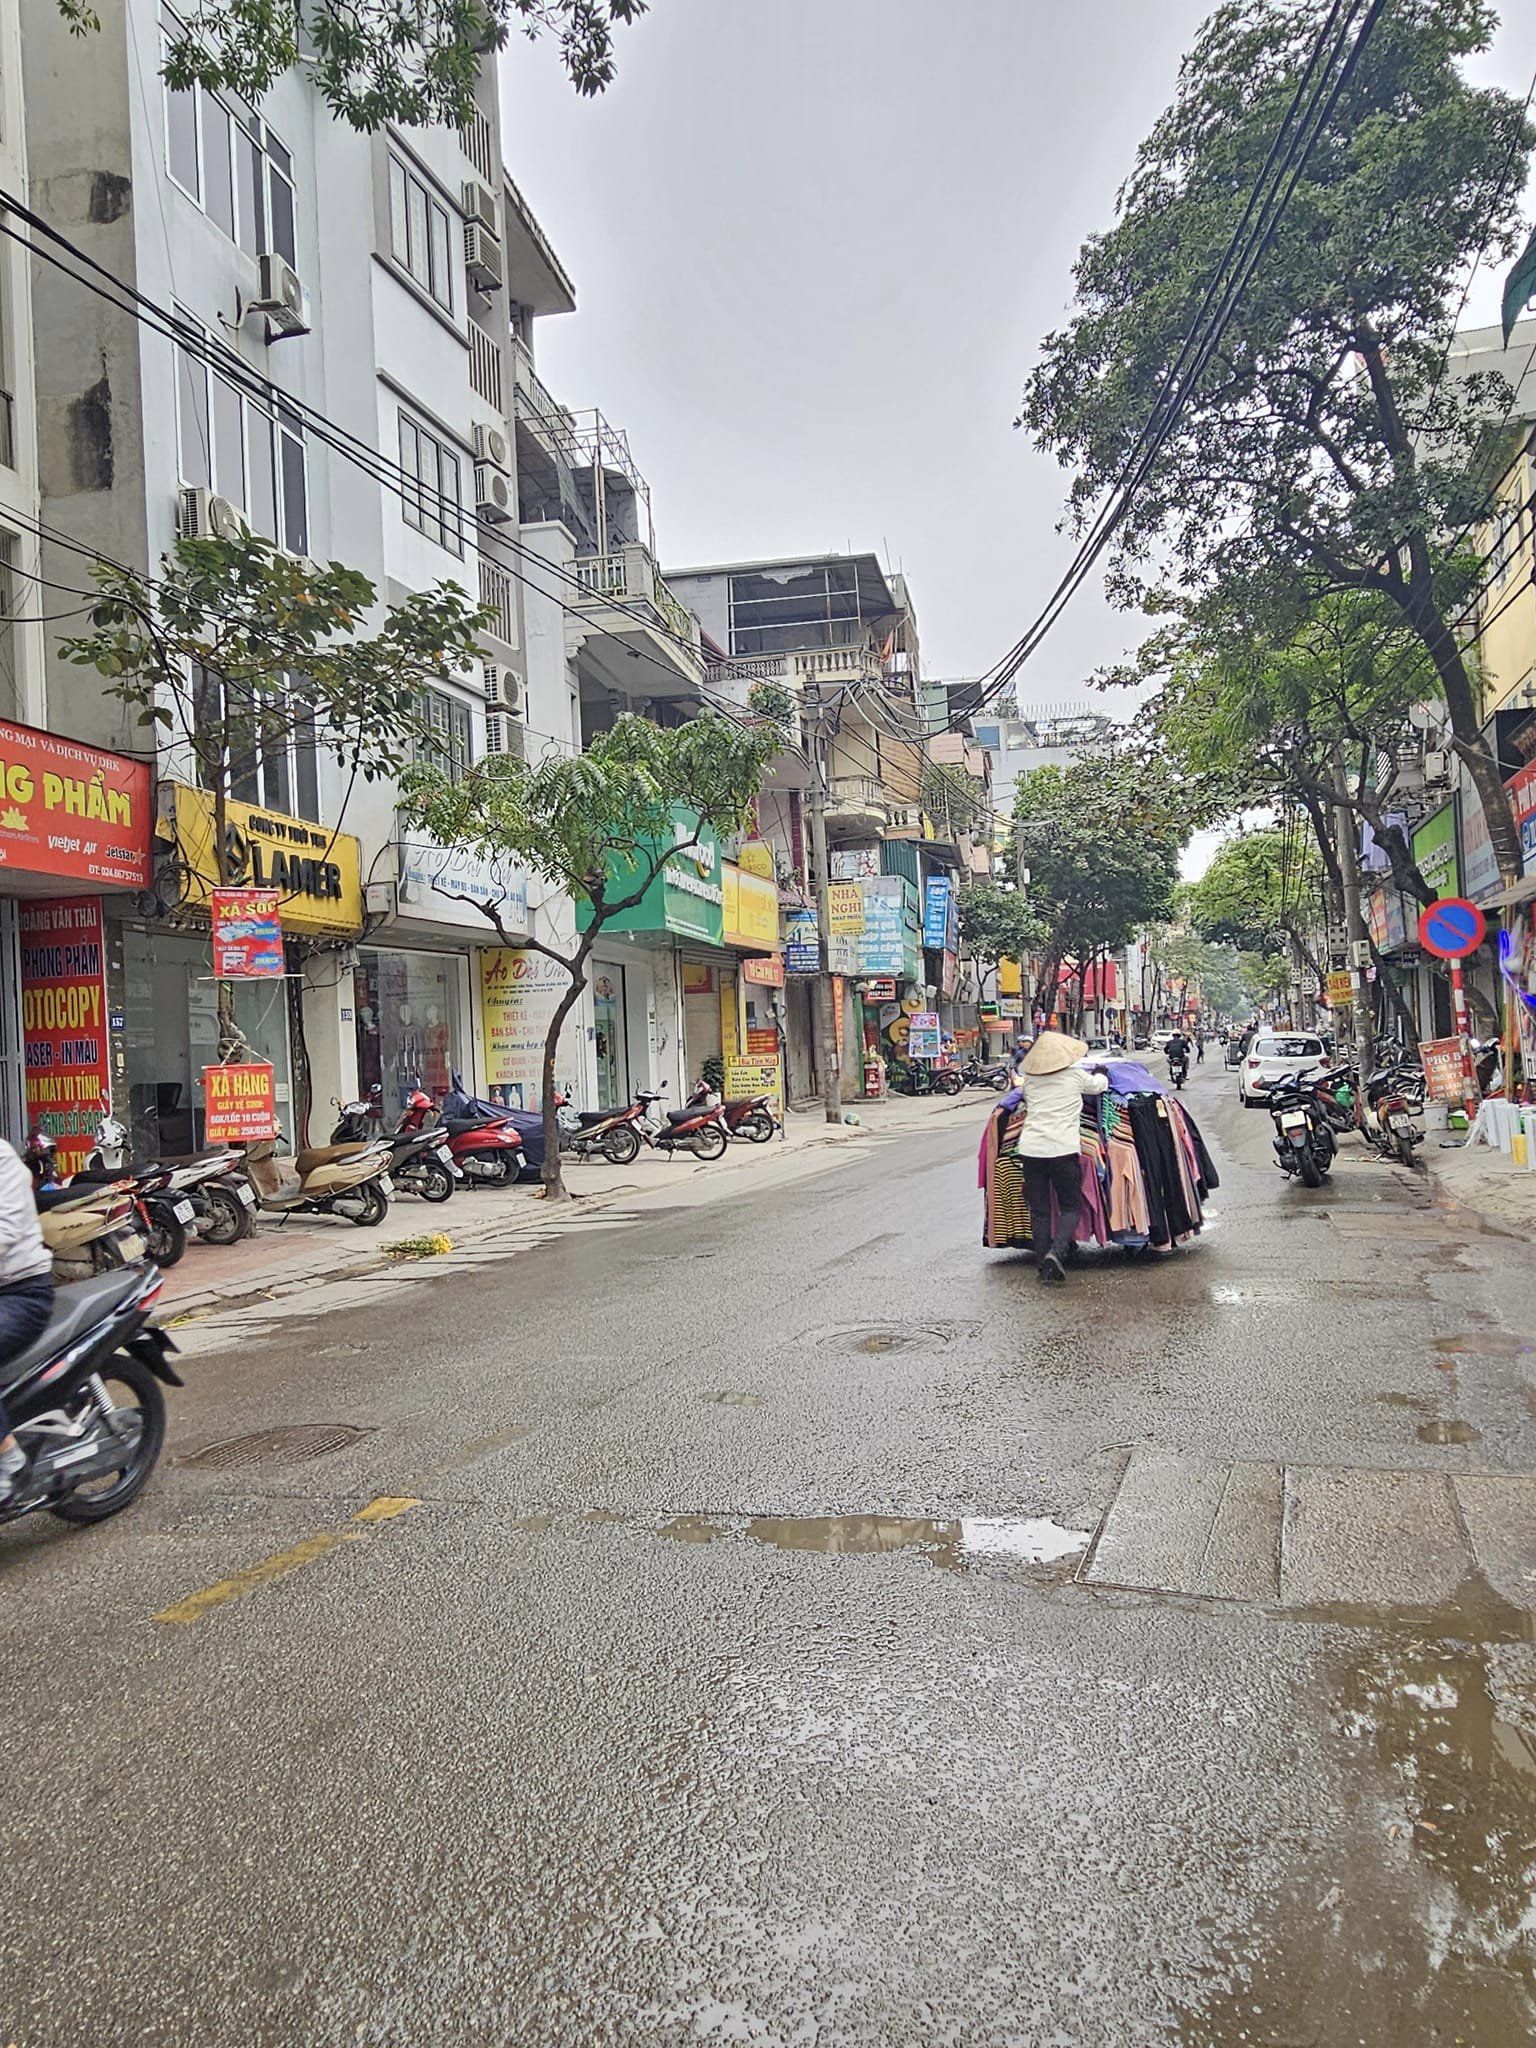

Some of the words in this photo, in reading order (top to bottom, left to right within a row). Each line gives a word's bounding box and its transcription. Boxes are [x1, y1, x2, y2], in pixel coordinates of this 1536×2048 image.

[15, 732, 37, 749] MẠI
[40, 739, 55, 753] VÀ
[56, 745, 82, 760] DỊCH
[83, 752, 98, 768] VỤ
[43, 767, 132, 828] PHẨM
[48, 834, 81, 854] Vietjet
[83, 841, 98, 856] Air
[105, 845, 134, 862] Jetstar
[251, 844, 343, 900] LAMER
[831, 898, 862, 914] NGHỈ
[832, 885, 859, 901] NHÀ
[51, 906, 72, 928] VĂN
[74, 903, 97, 928] THÁI
[220, 901, 241, 918] XẢ
[64, 930, 100, 976] PHẨM
[484, 951, 509, 985] Áo
[61, 1041, 72, 1065] IN
[74, 1033, 99, 1065] MÀU
[39, 1073, 62, 1102] MÁY
[63, 1077, 75, 1101] VI
[76, 1070, 100, 1100] TÍNH
[211, 1068, 231, 1098] XẢ
[233, 1070, 270, 1097] HÀNG
[81, 1104, 103, 1136] SÁC
